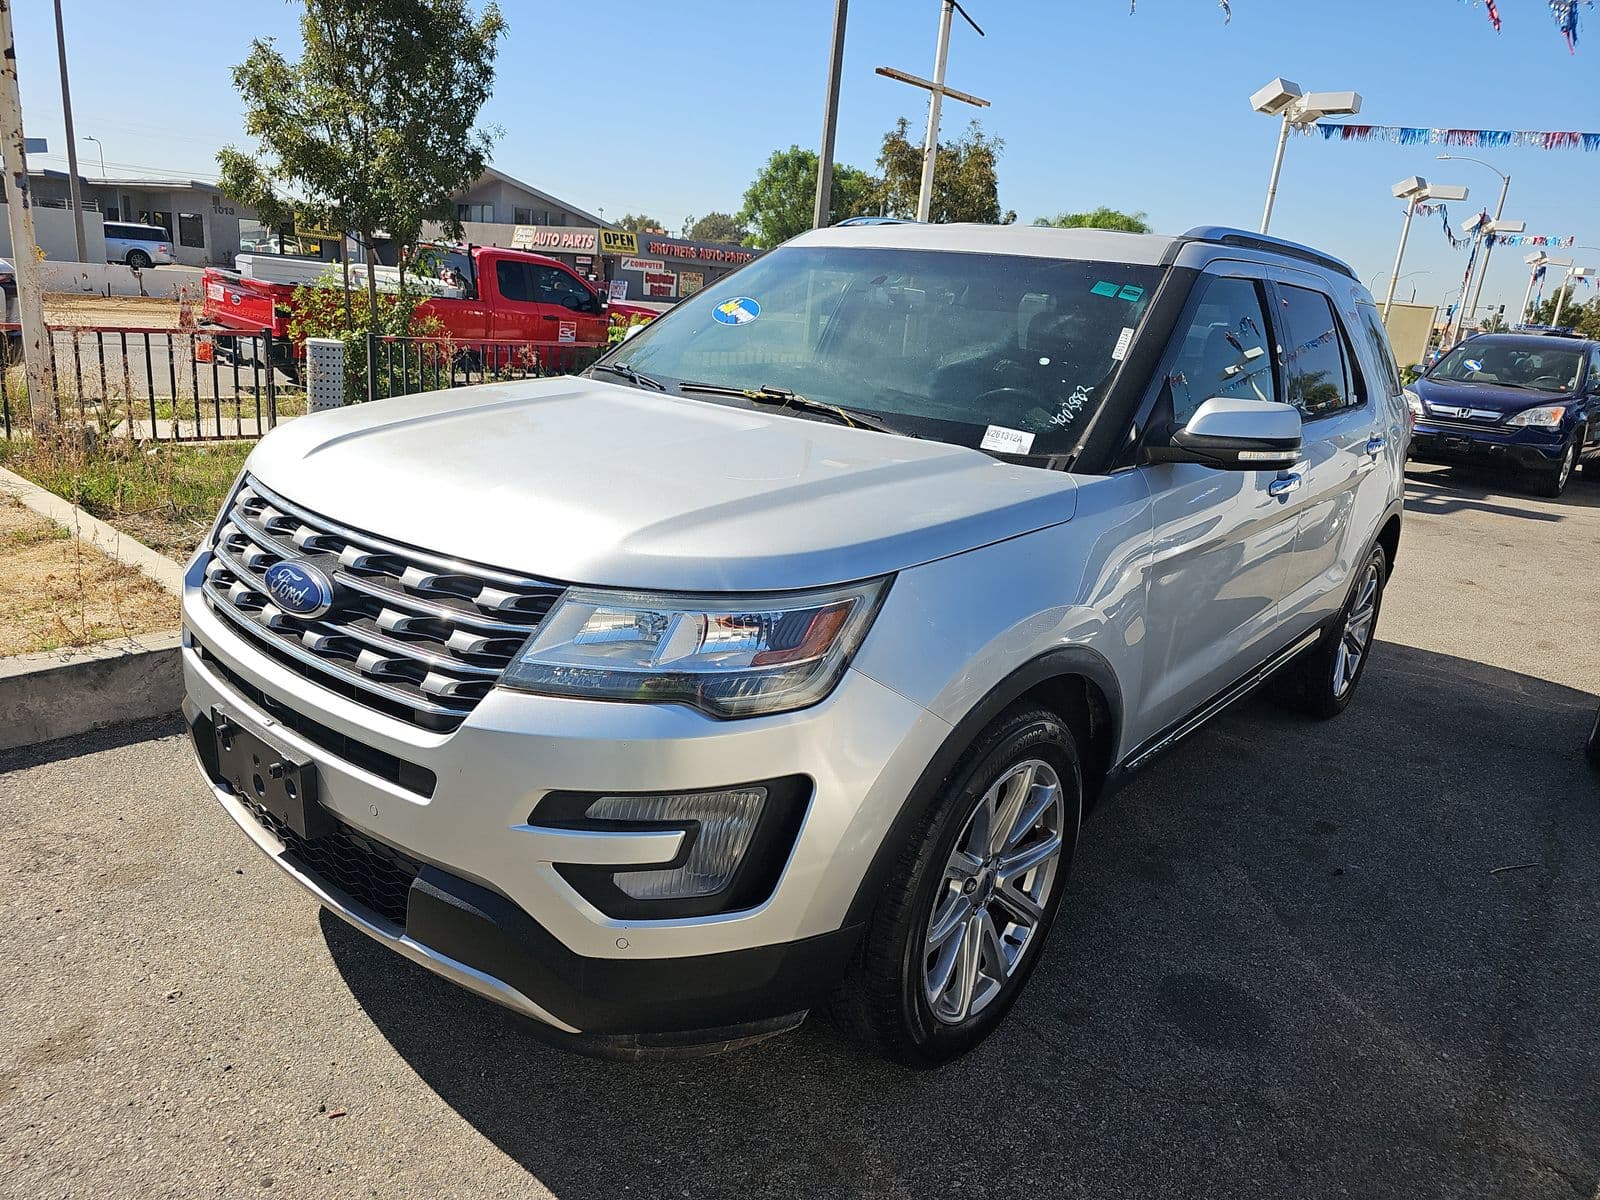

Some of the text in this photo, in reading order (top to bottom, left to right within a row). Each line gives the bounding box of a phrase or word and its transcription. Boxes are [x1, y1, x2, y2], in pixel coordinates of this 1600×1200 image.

[213, 206, 235, 215] 1013
[533, 231, 595, 249] AUTO PARTS
[604, 232, 634, 247] OPEN
[649, 240, 697, 258] BROTHERS
[630, 260, 663, 269] COMPUTER
[270, 568, 310, 607] Ford
